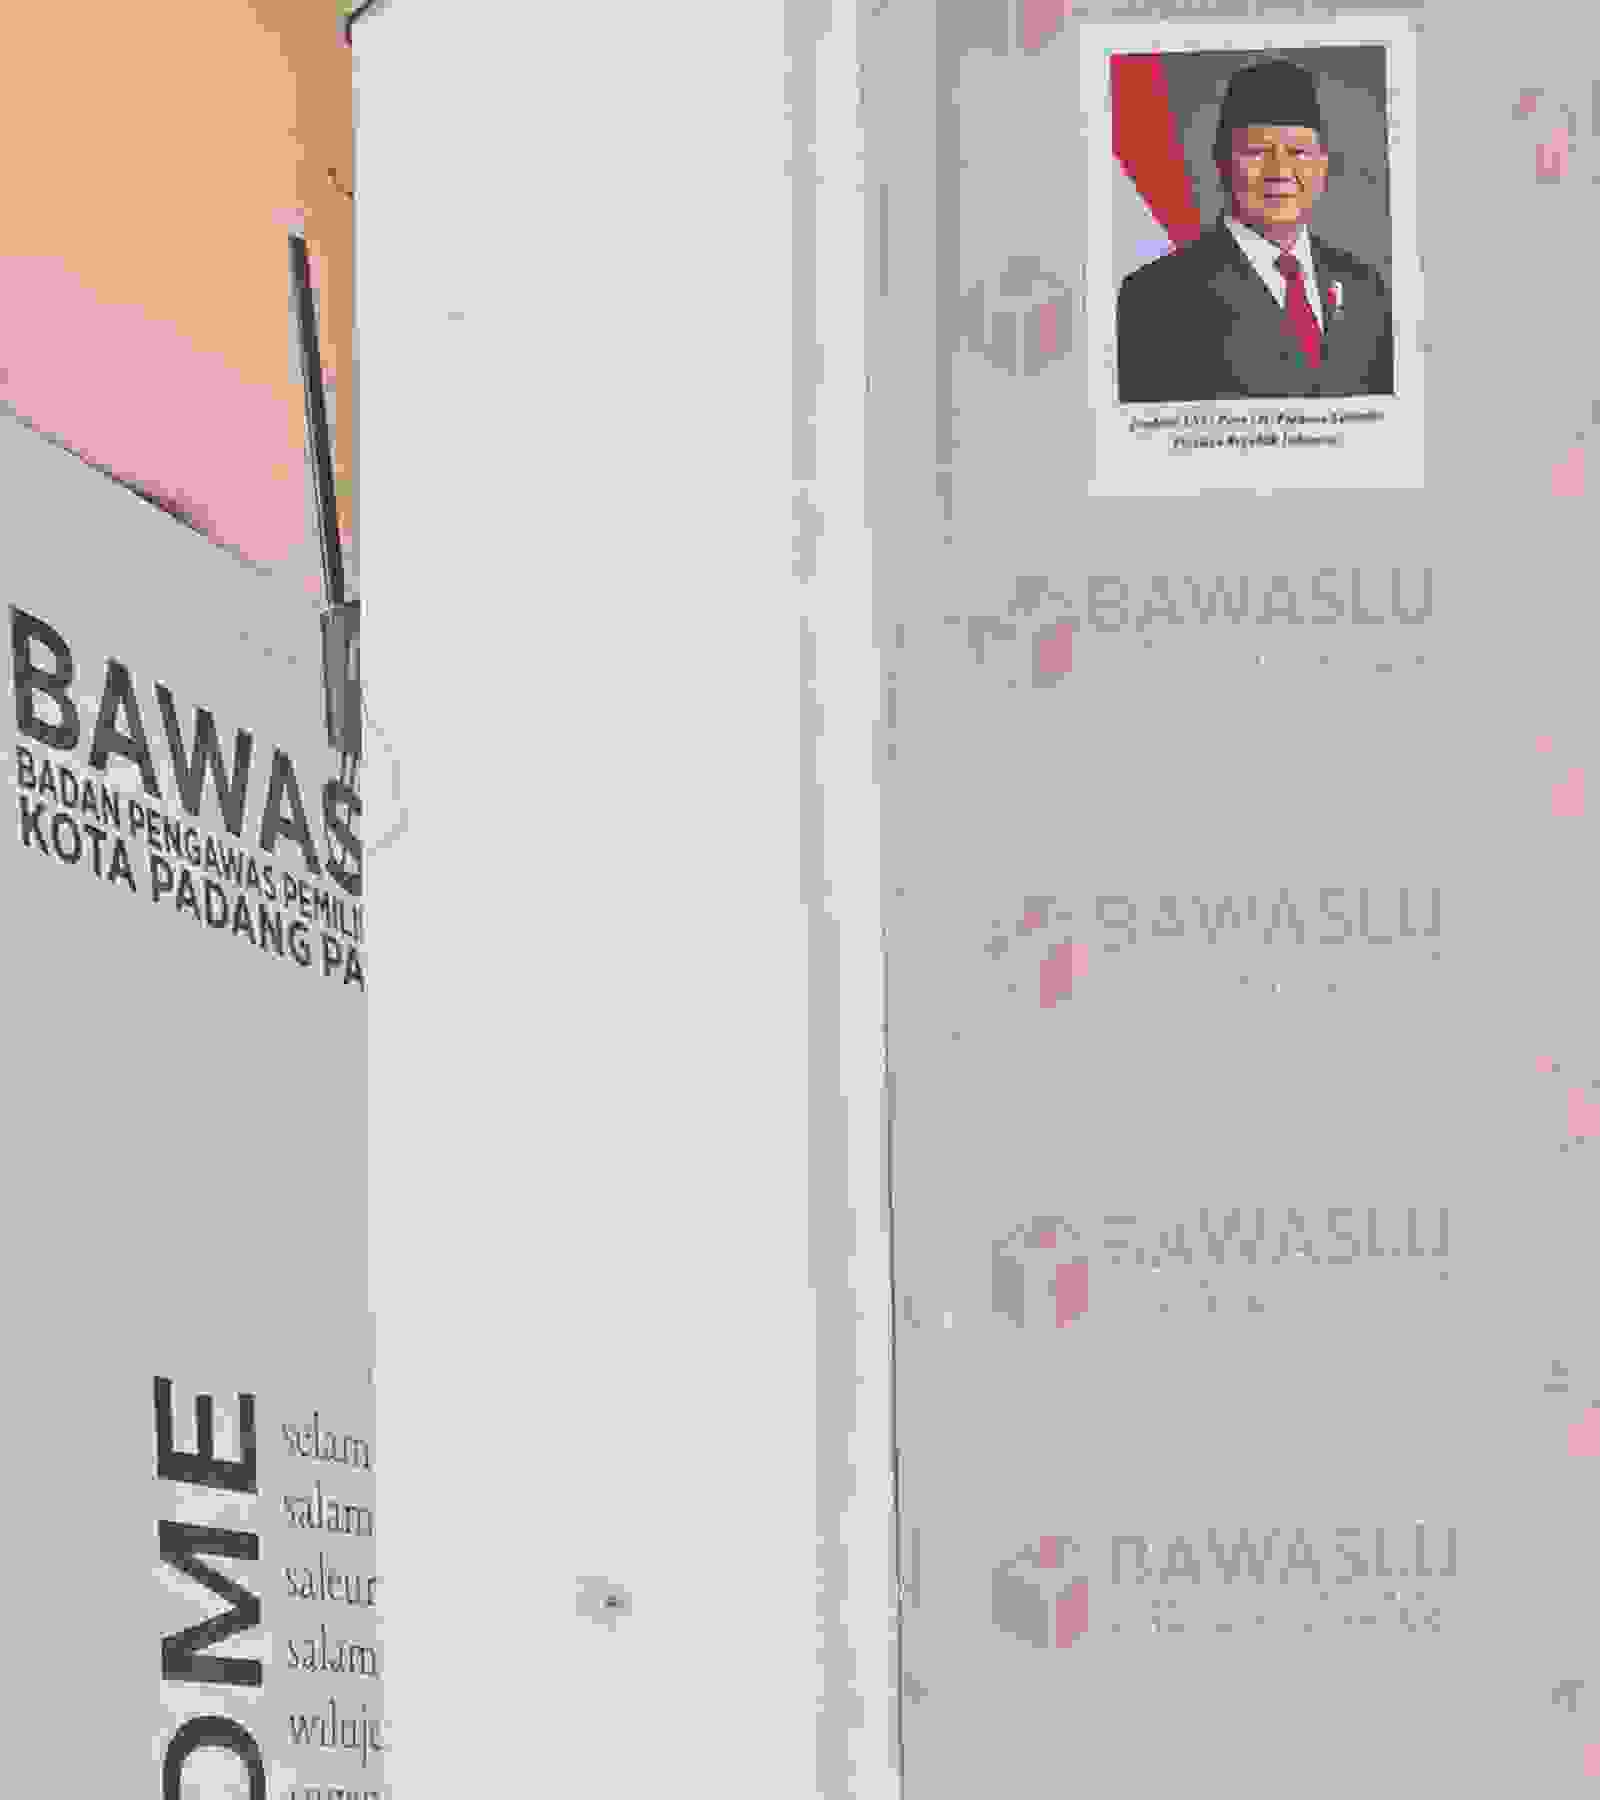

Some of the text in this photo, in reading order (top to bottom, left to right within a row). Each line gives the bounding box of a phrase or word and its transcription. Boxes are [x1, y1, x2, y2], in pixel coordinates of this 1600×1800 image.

[1086, 566, 1434, 634] BAWASLU
[16, 744, 121, 830] BADAN
[129, 799, 278, 905] PENGAWAS
[18, 794, 137, 894] KOTA
[149, 853, 313, 968] PADANG
[1111, 1525, 1458, 1588] BAWASLU
